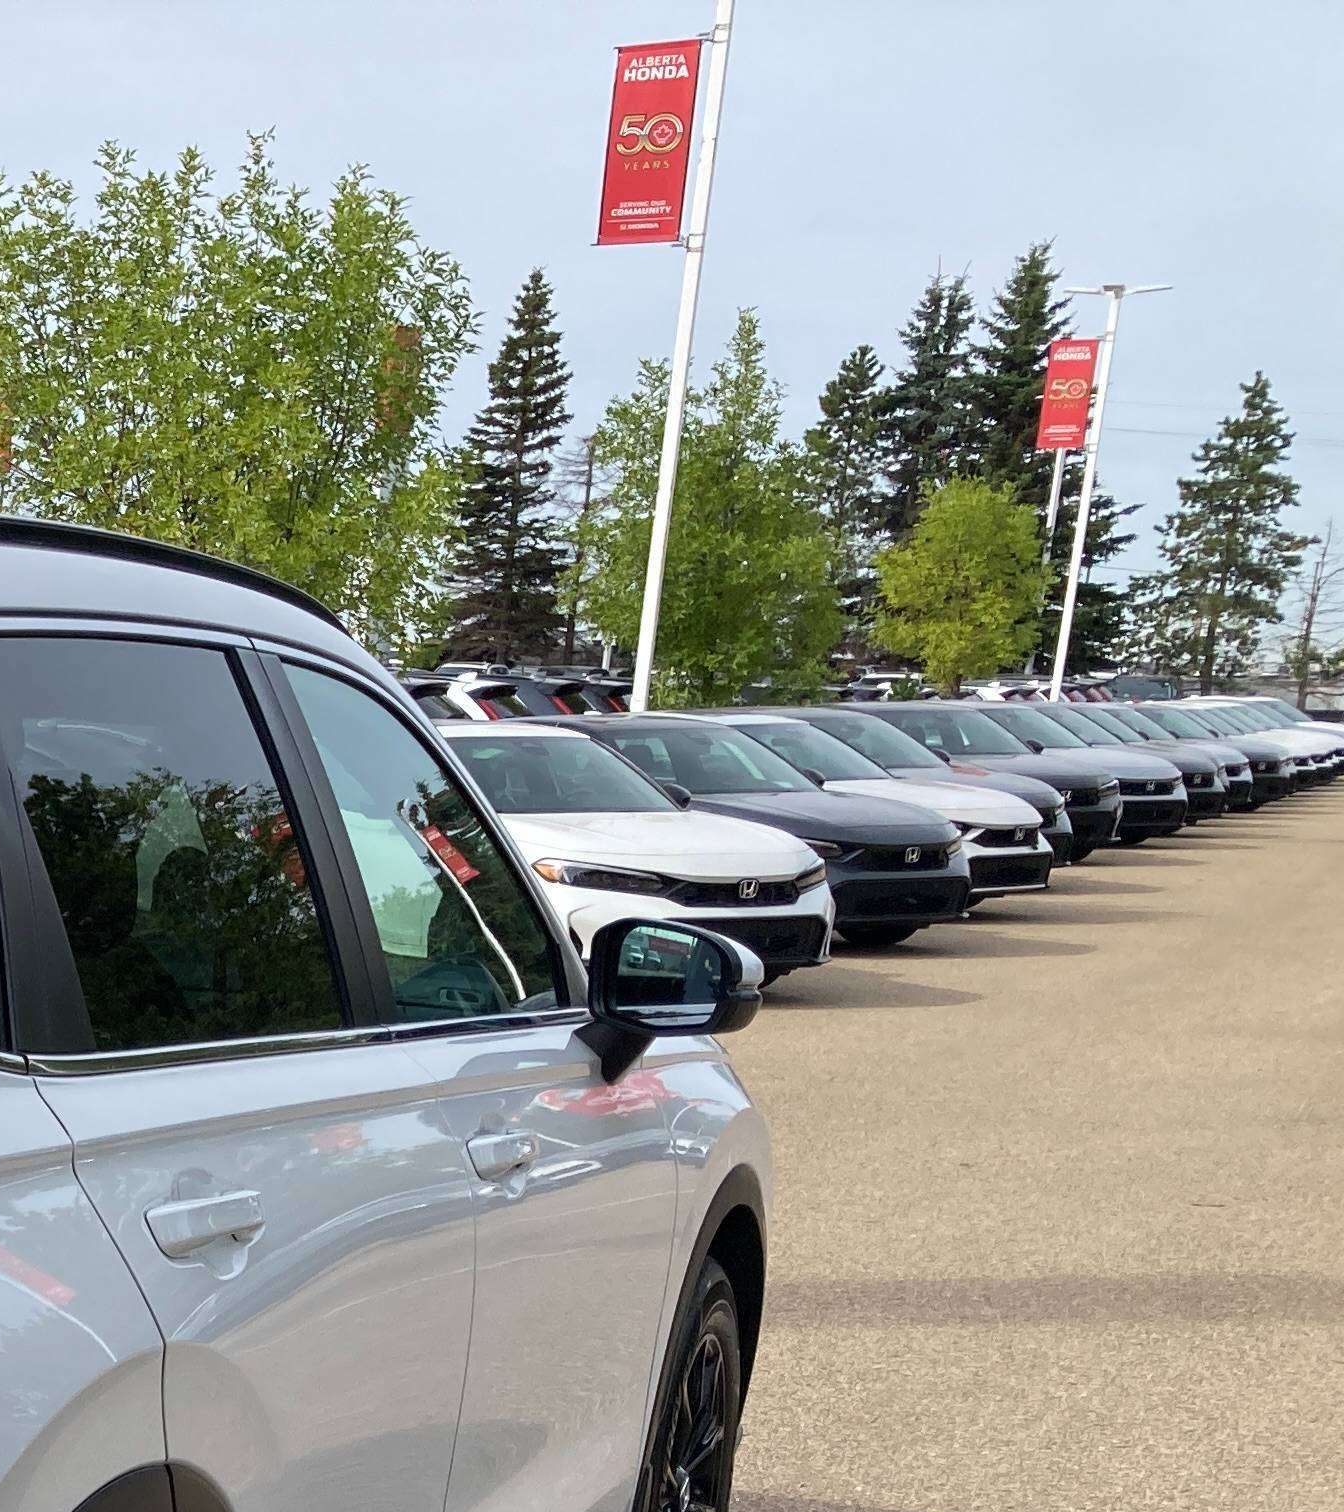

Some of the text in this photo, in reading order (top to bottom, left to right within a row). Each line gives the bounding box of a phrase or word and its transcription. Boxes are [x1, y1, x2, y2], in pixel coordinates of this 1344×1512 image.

[629, 54, 687, 68] ALBERTA
[623, 65, 689, 82] HONDA
[616, 112, 684, 155] 50
[623, 160, 670, 171] YEARS
[610, 206, 673, 217] COMMUNITY
